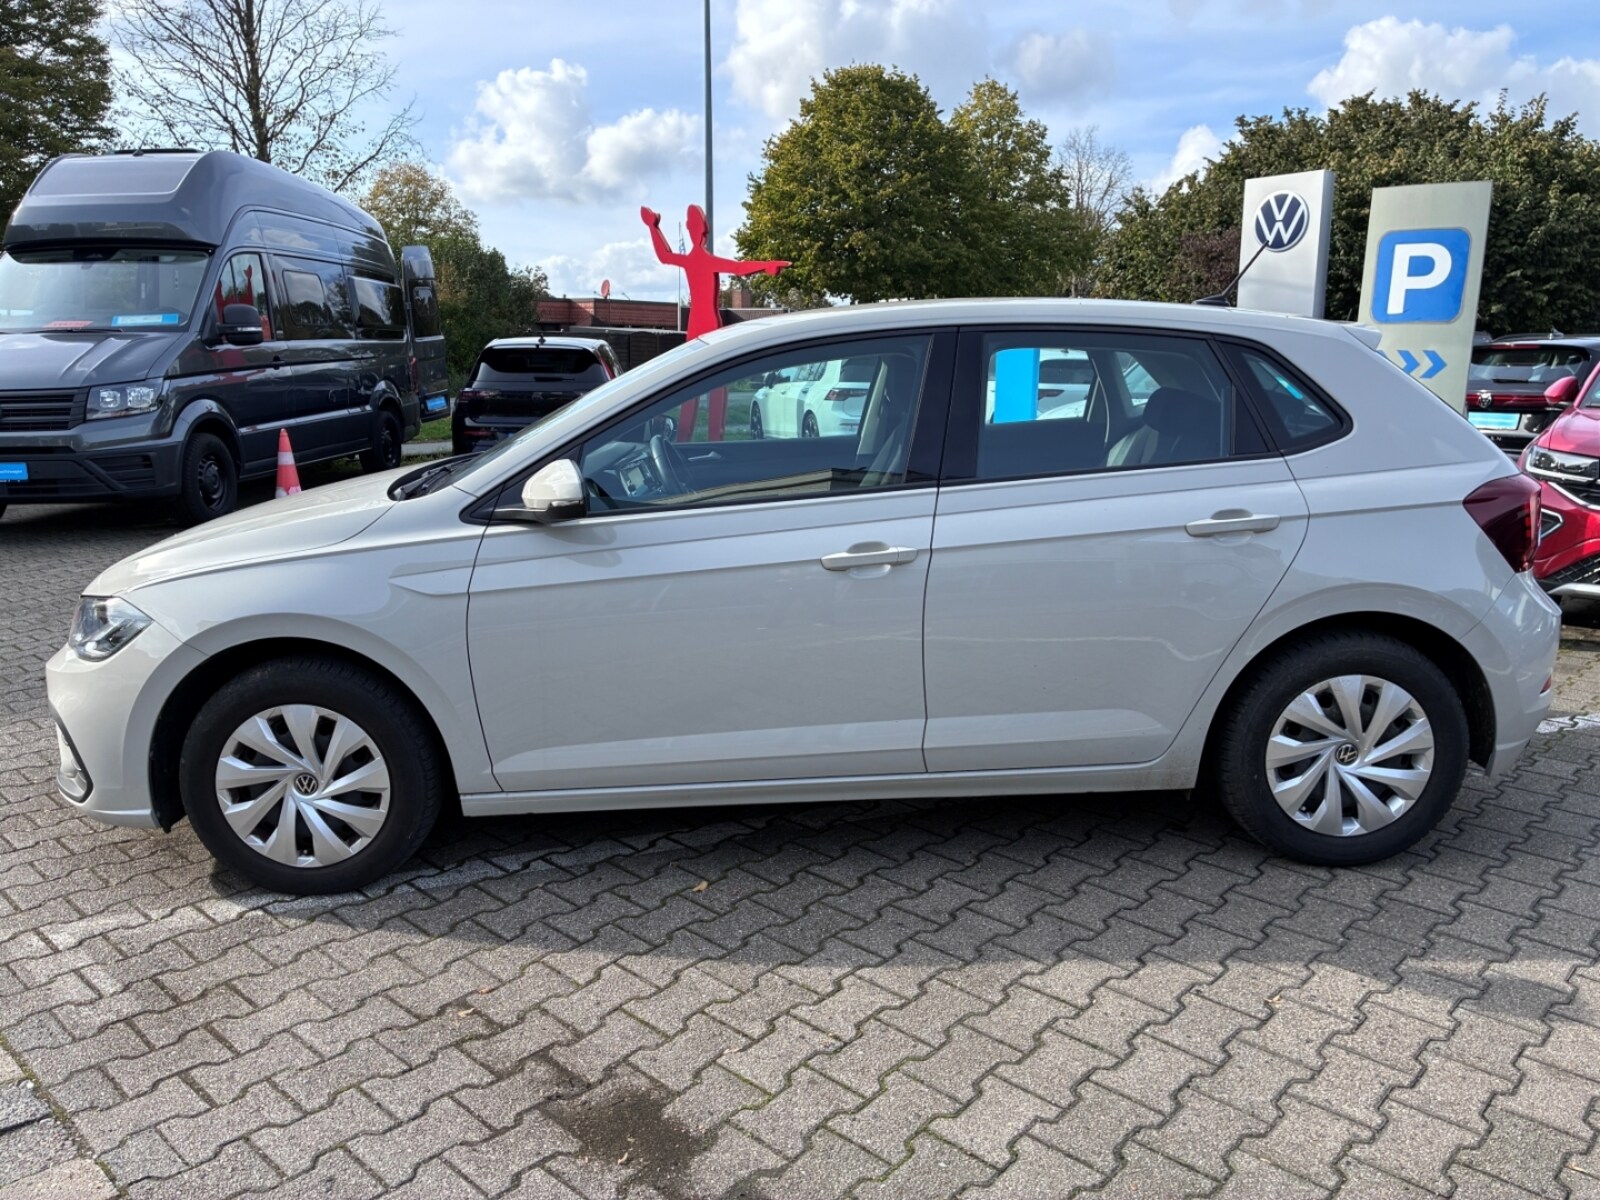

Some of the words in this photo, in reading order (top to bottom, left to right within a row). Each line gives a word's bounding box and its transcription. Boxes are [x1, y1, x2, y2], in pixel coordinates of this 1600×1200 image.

[1254, 190, 1307, 250] VW
[1387, 242, 1452, 315] P
[295, 774, 317, 795] VW
